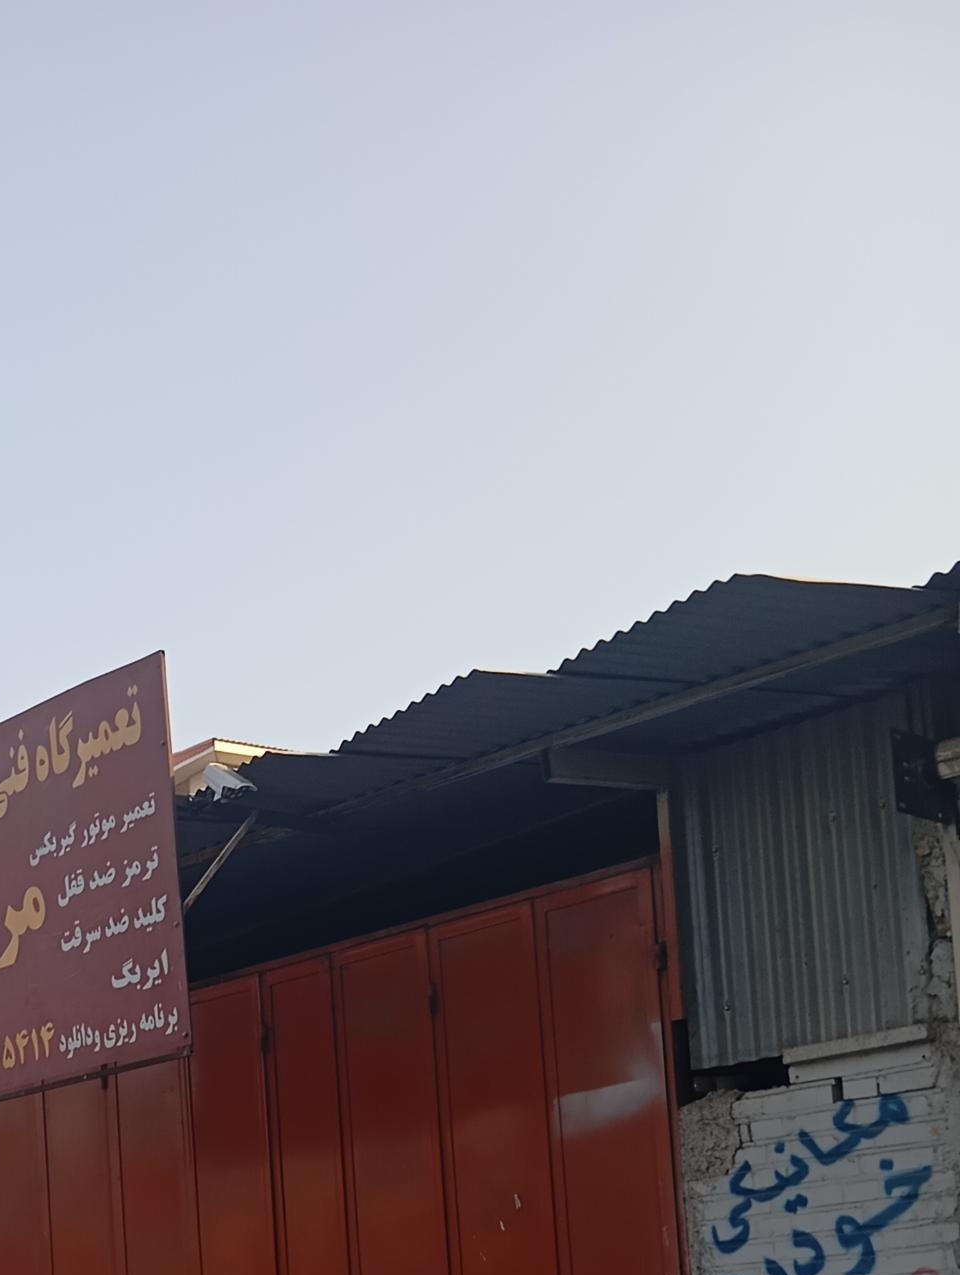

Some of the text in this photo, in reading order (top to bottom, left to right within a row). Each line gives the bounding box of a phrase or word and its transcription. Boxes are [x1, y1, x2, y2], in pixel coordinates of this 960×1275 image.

[35, 684, 141, 788] تعمیرگاه
[29, 792, 156, 866] تعمیر موتور گیربکس
[58, 846, 159, 907] ترمز ضد قفل
[60, 894, 168, 953] کلید ضد سرقت
[104, 1018, 137, 1049] ریزی
[139, 1003, 178, 1035] برنامه
